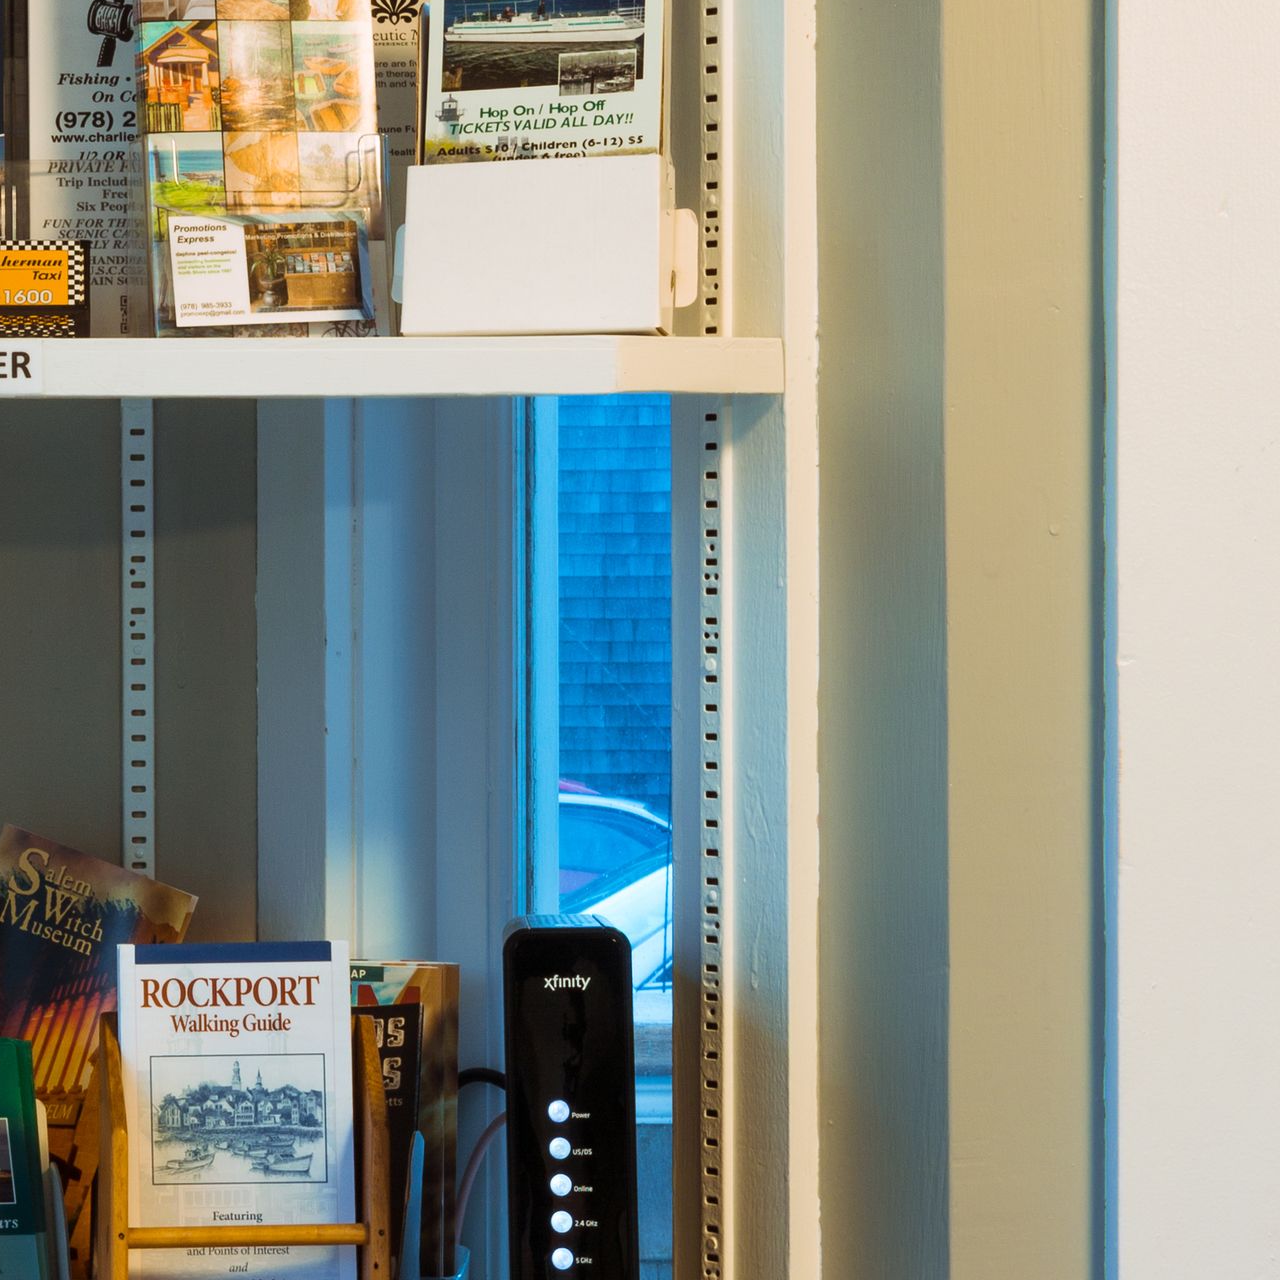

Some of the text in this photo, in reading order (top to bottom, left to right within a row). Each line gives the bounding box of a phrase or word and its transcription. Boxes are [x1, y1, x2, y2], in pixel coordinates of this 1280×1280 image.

[480, 105, 510, 120] Hop
[514, 103, 534, 117] On
[548, 102, 578, 117] Hop
[582, 99, 606, 114] Off
[450, 113, 634, 135] TICKETS VALID ALL DAY!!
[32, 269, 61, 281] Taxi
[9, 848, 92, 896] Salem
[0, 892, 92, 956] Museum
[44, 892, 104, 940] Witch
[140, 975, 319, 1010] ROCKPORT
[544, 975, 591, 991] xfinity
[170, 1013, 291, 1038] Walking Guide
[212, 1210, 262, 1224] Featuring
